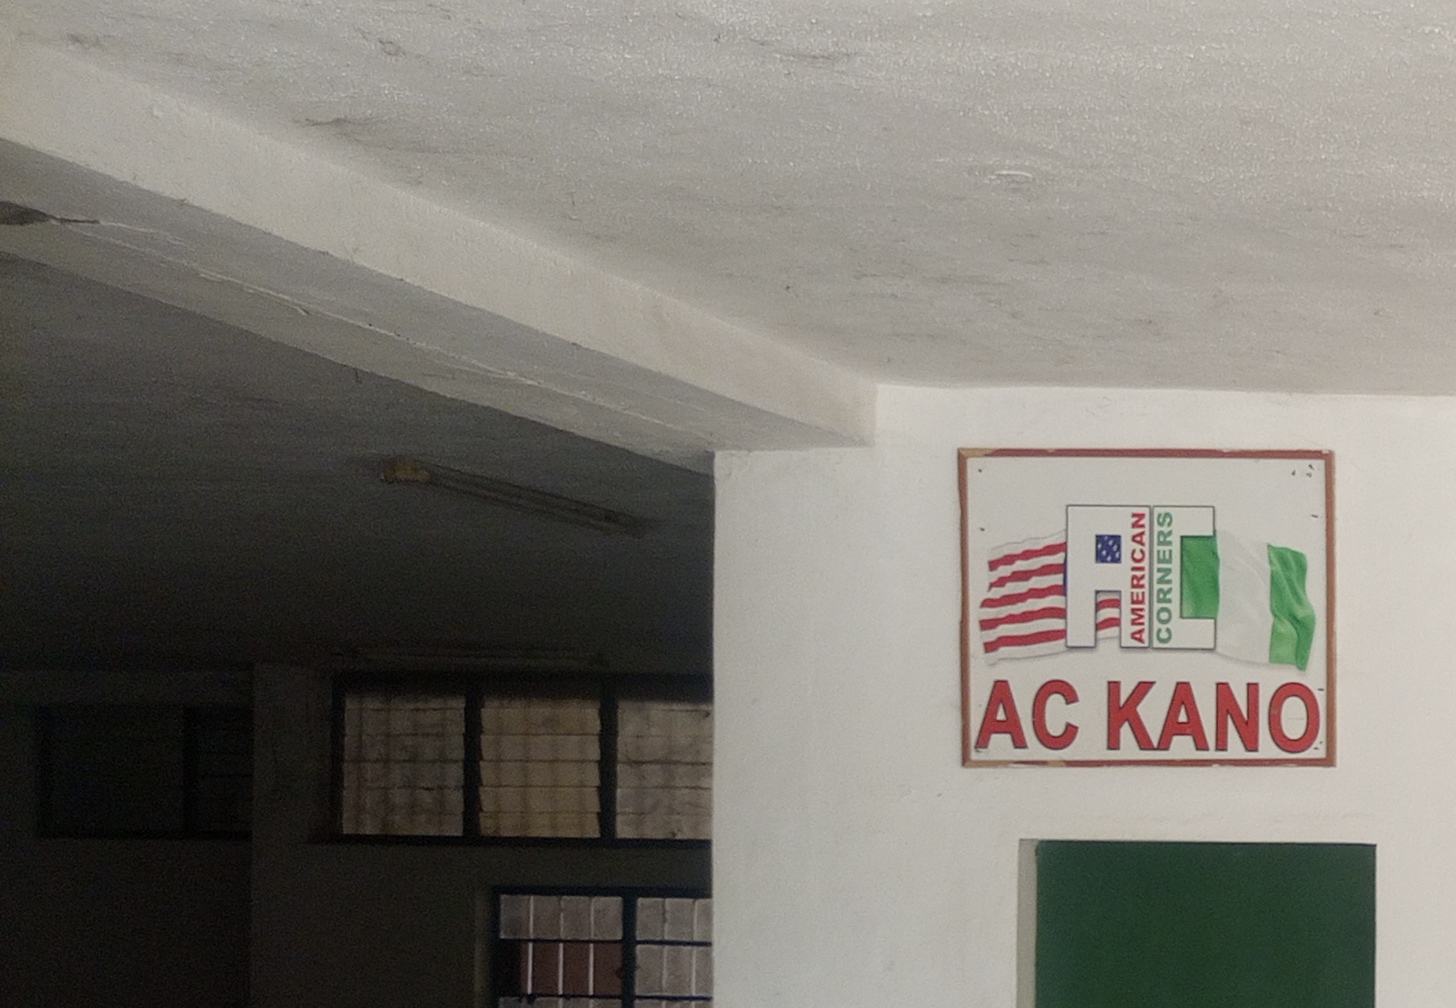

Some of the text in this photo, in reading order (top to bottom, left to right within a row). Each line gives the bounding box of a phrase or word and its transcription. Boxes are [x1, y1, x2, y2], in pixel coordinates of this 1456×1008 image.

[1130, 512, 1146, 644] AMERICAN
[1156, 511, 1173, 645] CORNERS
[975, 679, 1321, 753] AC KANO
